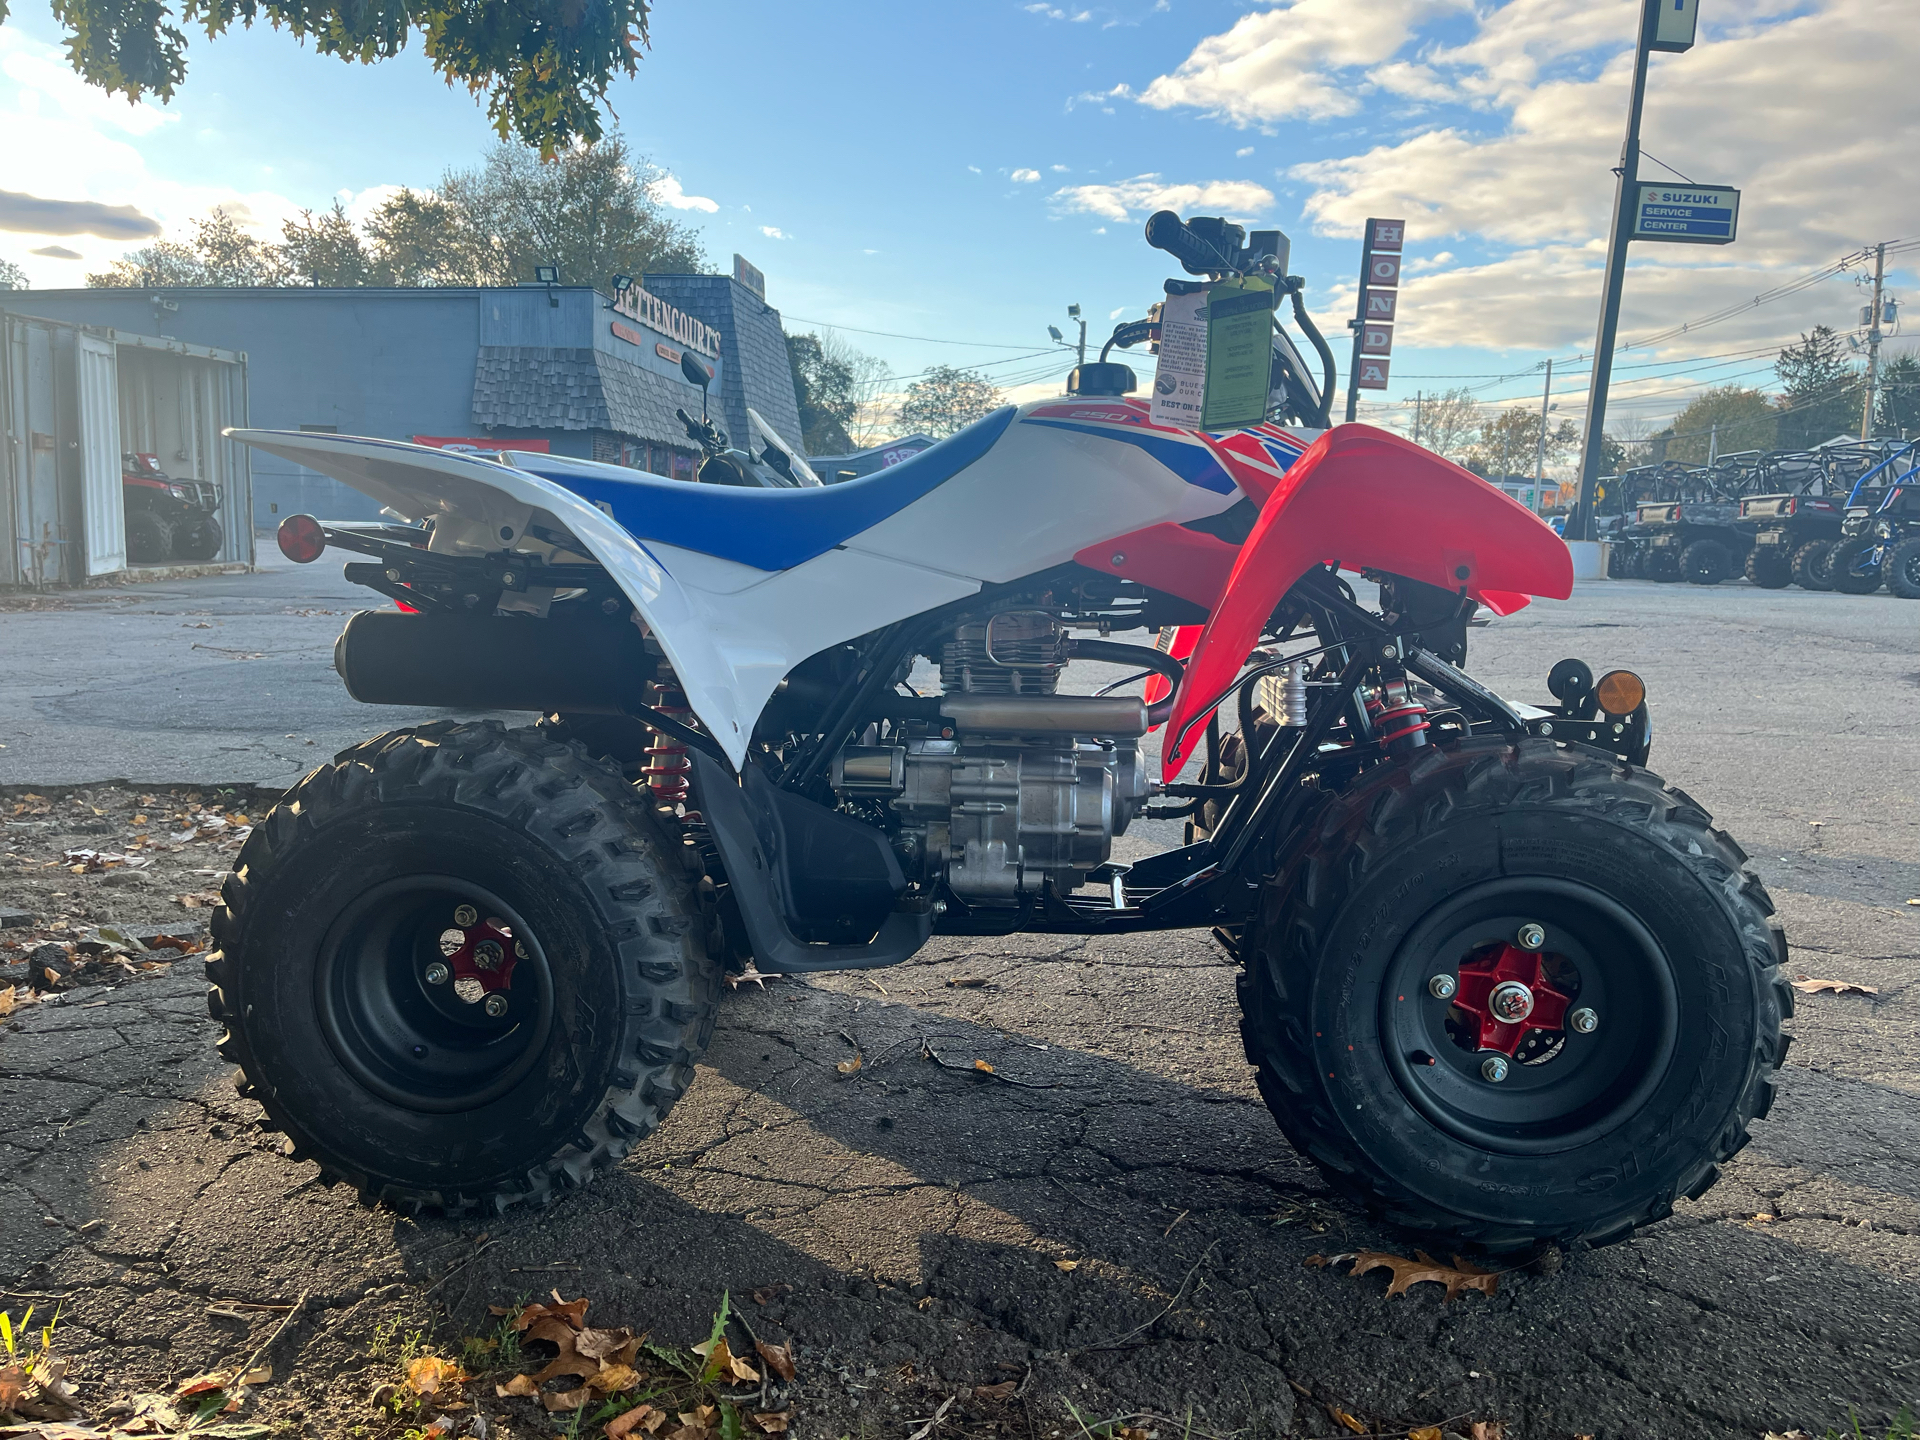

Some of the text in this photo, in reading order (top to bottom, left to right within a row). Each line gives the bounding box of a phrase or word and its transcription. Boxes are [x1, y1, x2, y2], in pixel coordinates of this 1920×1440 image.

[1662, 193, 1718, 204] SUZUKI
[1645, 207, 1692, 217] SERVICE
[1644, 221, 1687, 230] CENTER
[1361, 226, 1401, 382] HONDA
[1180, 380, 1198, 388] BLUE
[1179, 388, 1195, 396] OUR
[1161, 400, 1181, 409] BEST
[1182, 403, 1193, 411] ON
[1576, 955, 1730, 1195] MAXXIS
